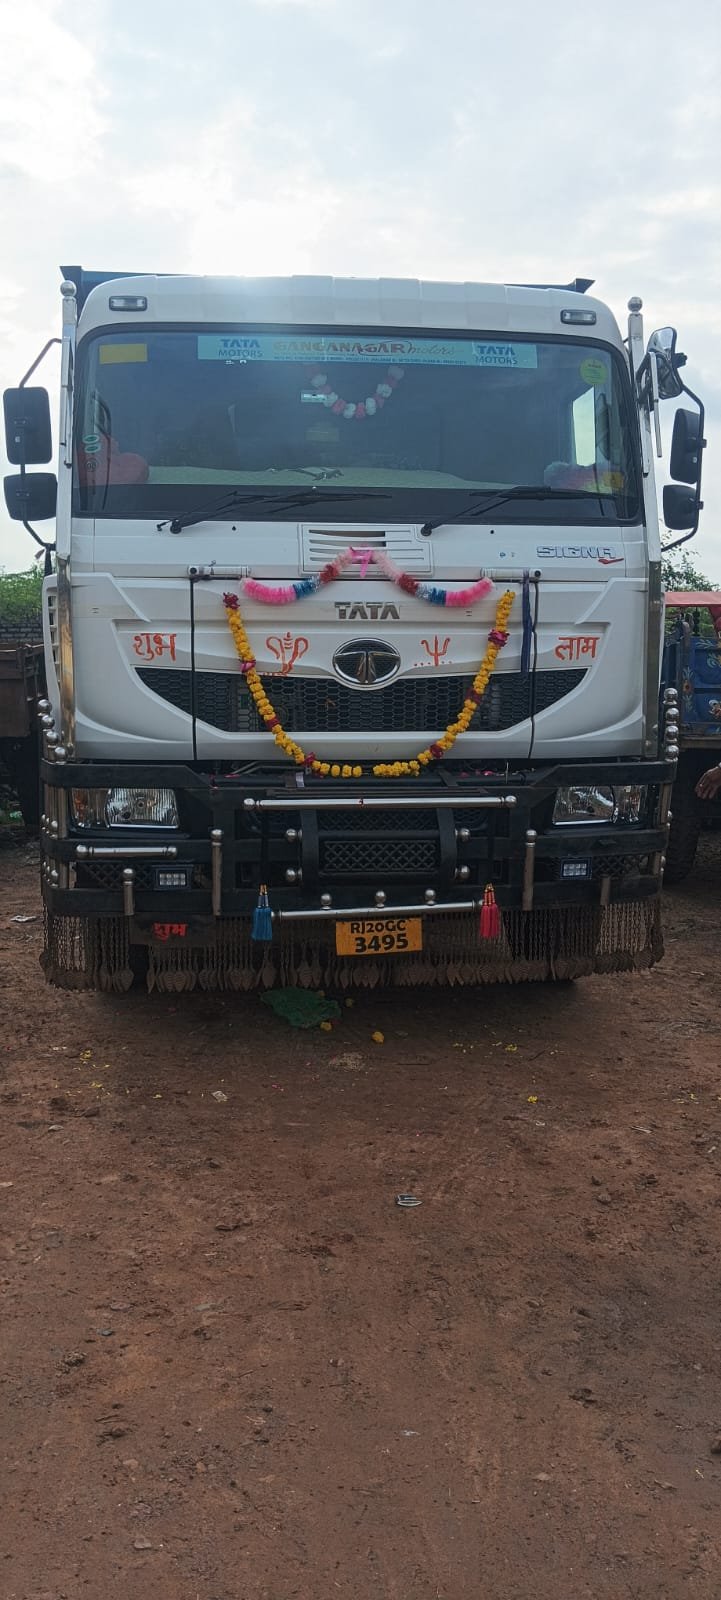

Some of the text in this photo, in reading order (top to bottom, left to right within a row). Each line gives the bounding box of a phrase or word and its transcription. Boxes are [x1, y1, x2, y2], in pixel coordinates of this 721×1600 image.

[220, 338, 260, 348] TATA
[477, 345, 516, 355] TATA
[218, 349, 263, 358] MOTORS
[474, 356, 518, 365] MOTORS
[536, 545, 617, 559] SIGNA
[334, 601, 401, 620] TATA
[132, 632, 177, 661] शुभ
[350, 920, 406, 934] RJ20GC
[354, 933, 409, 953] 3495
